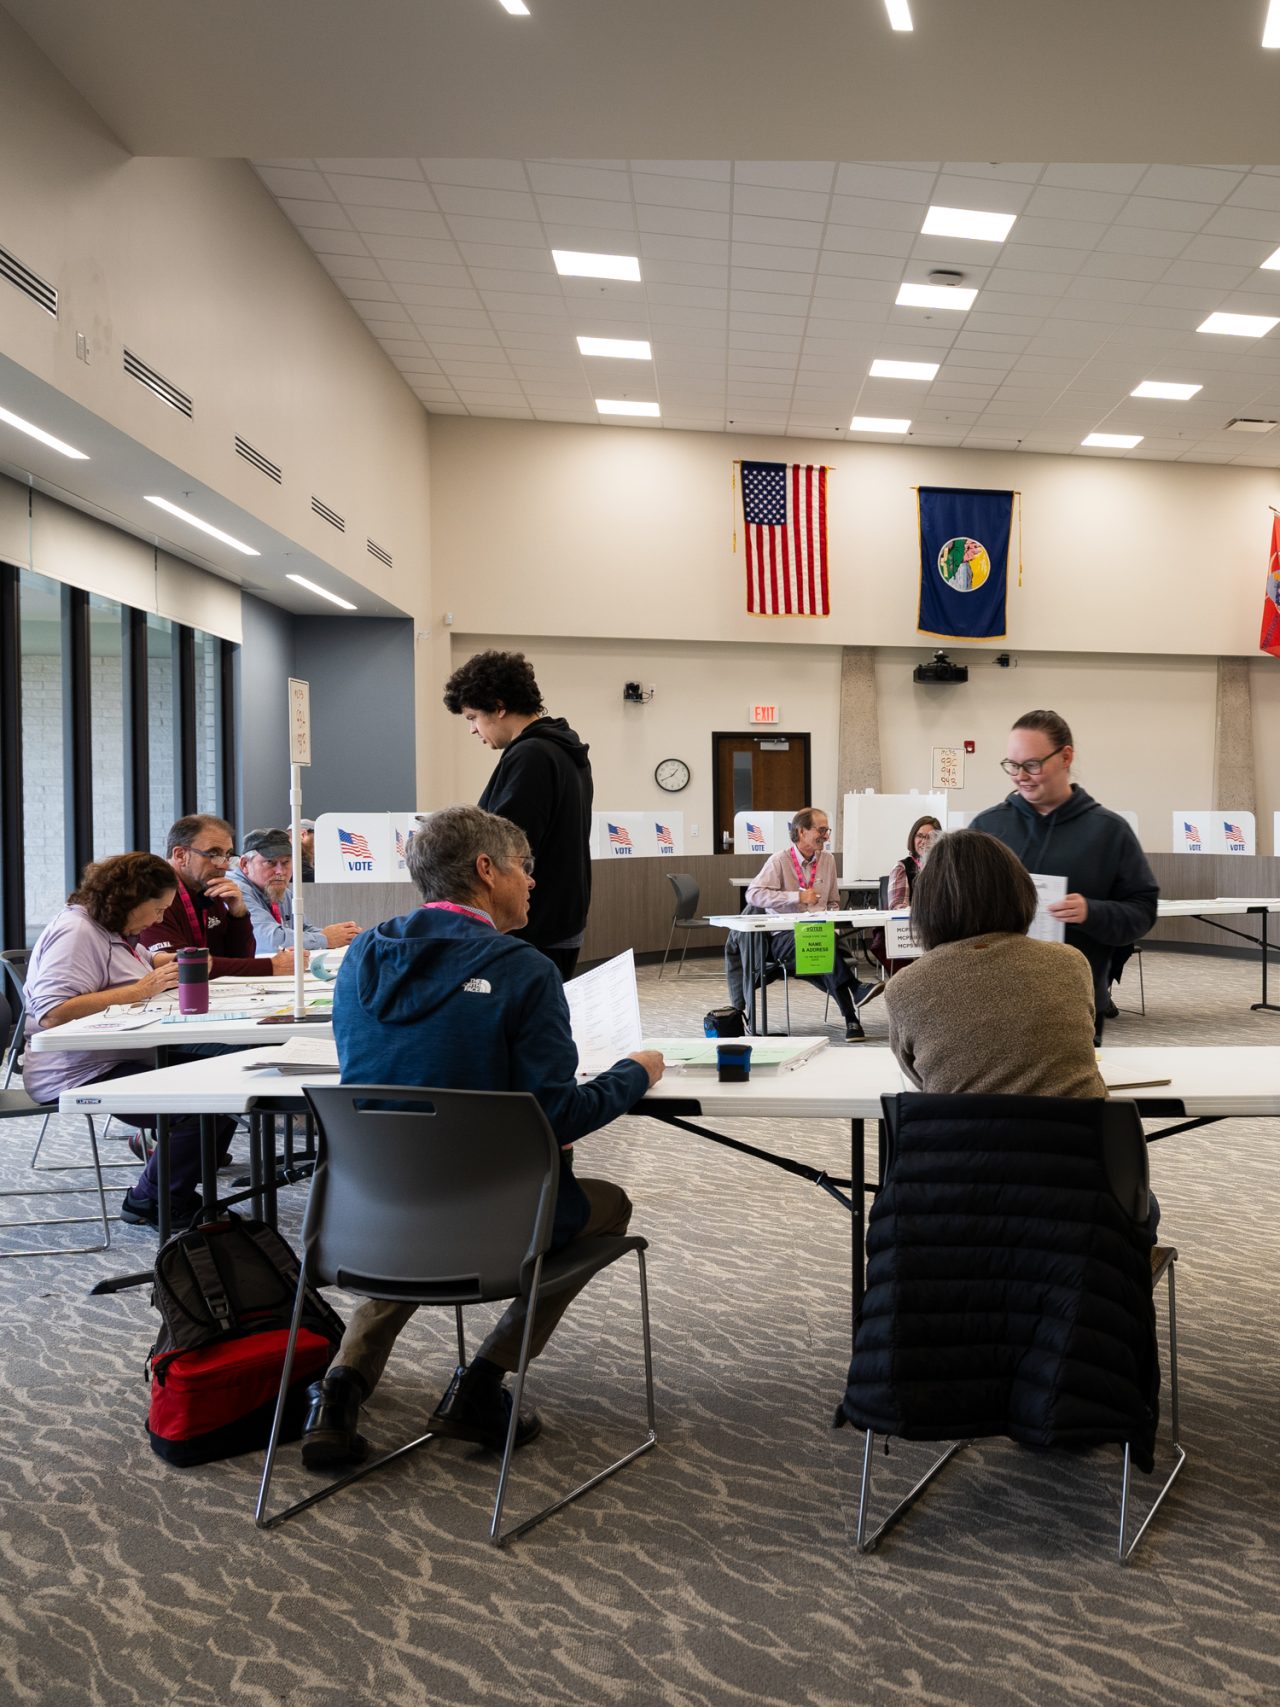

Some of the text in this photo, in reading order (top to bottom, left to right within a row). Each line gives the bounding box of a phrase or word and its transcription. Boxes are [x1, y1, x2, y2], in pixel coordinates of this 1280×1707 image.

[754, 706, 775, 721] EXIT
[615, 847, 633, 855] VOTE
[661, 846, 674, 854] VOTE
[751, 844, 765, 852] VOTE
[1189, 844, 1202, 852] VOTE
[1230, 844, 1246, 852] VOTE
[348, 861, 373, 871] VOTE
